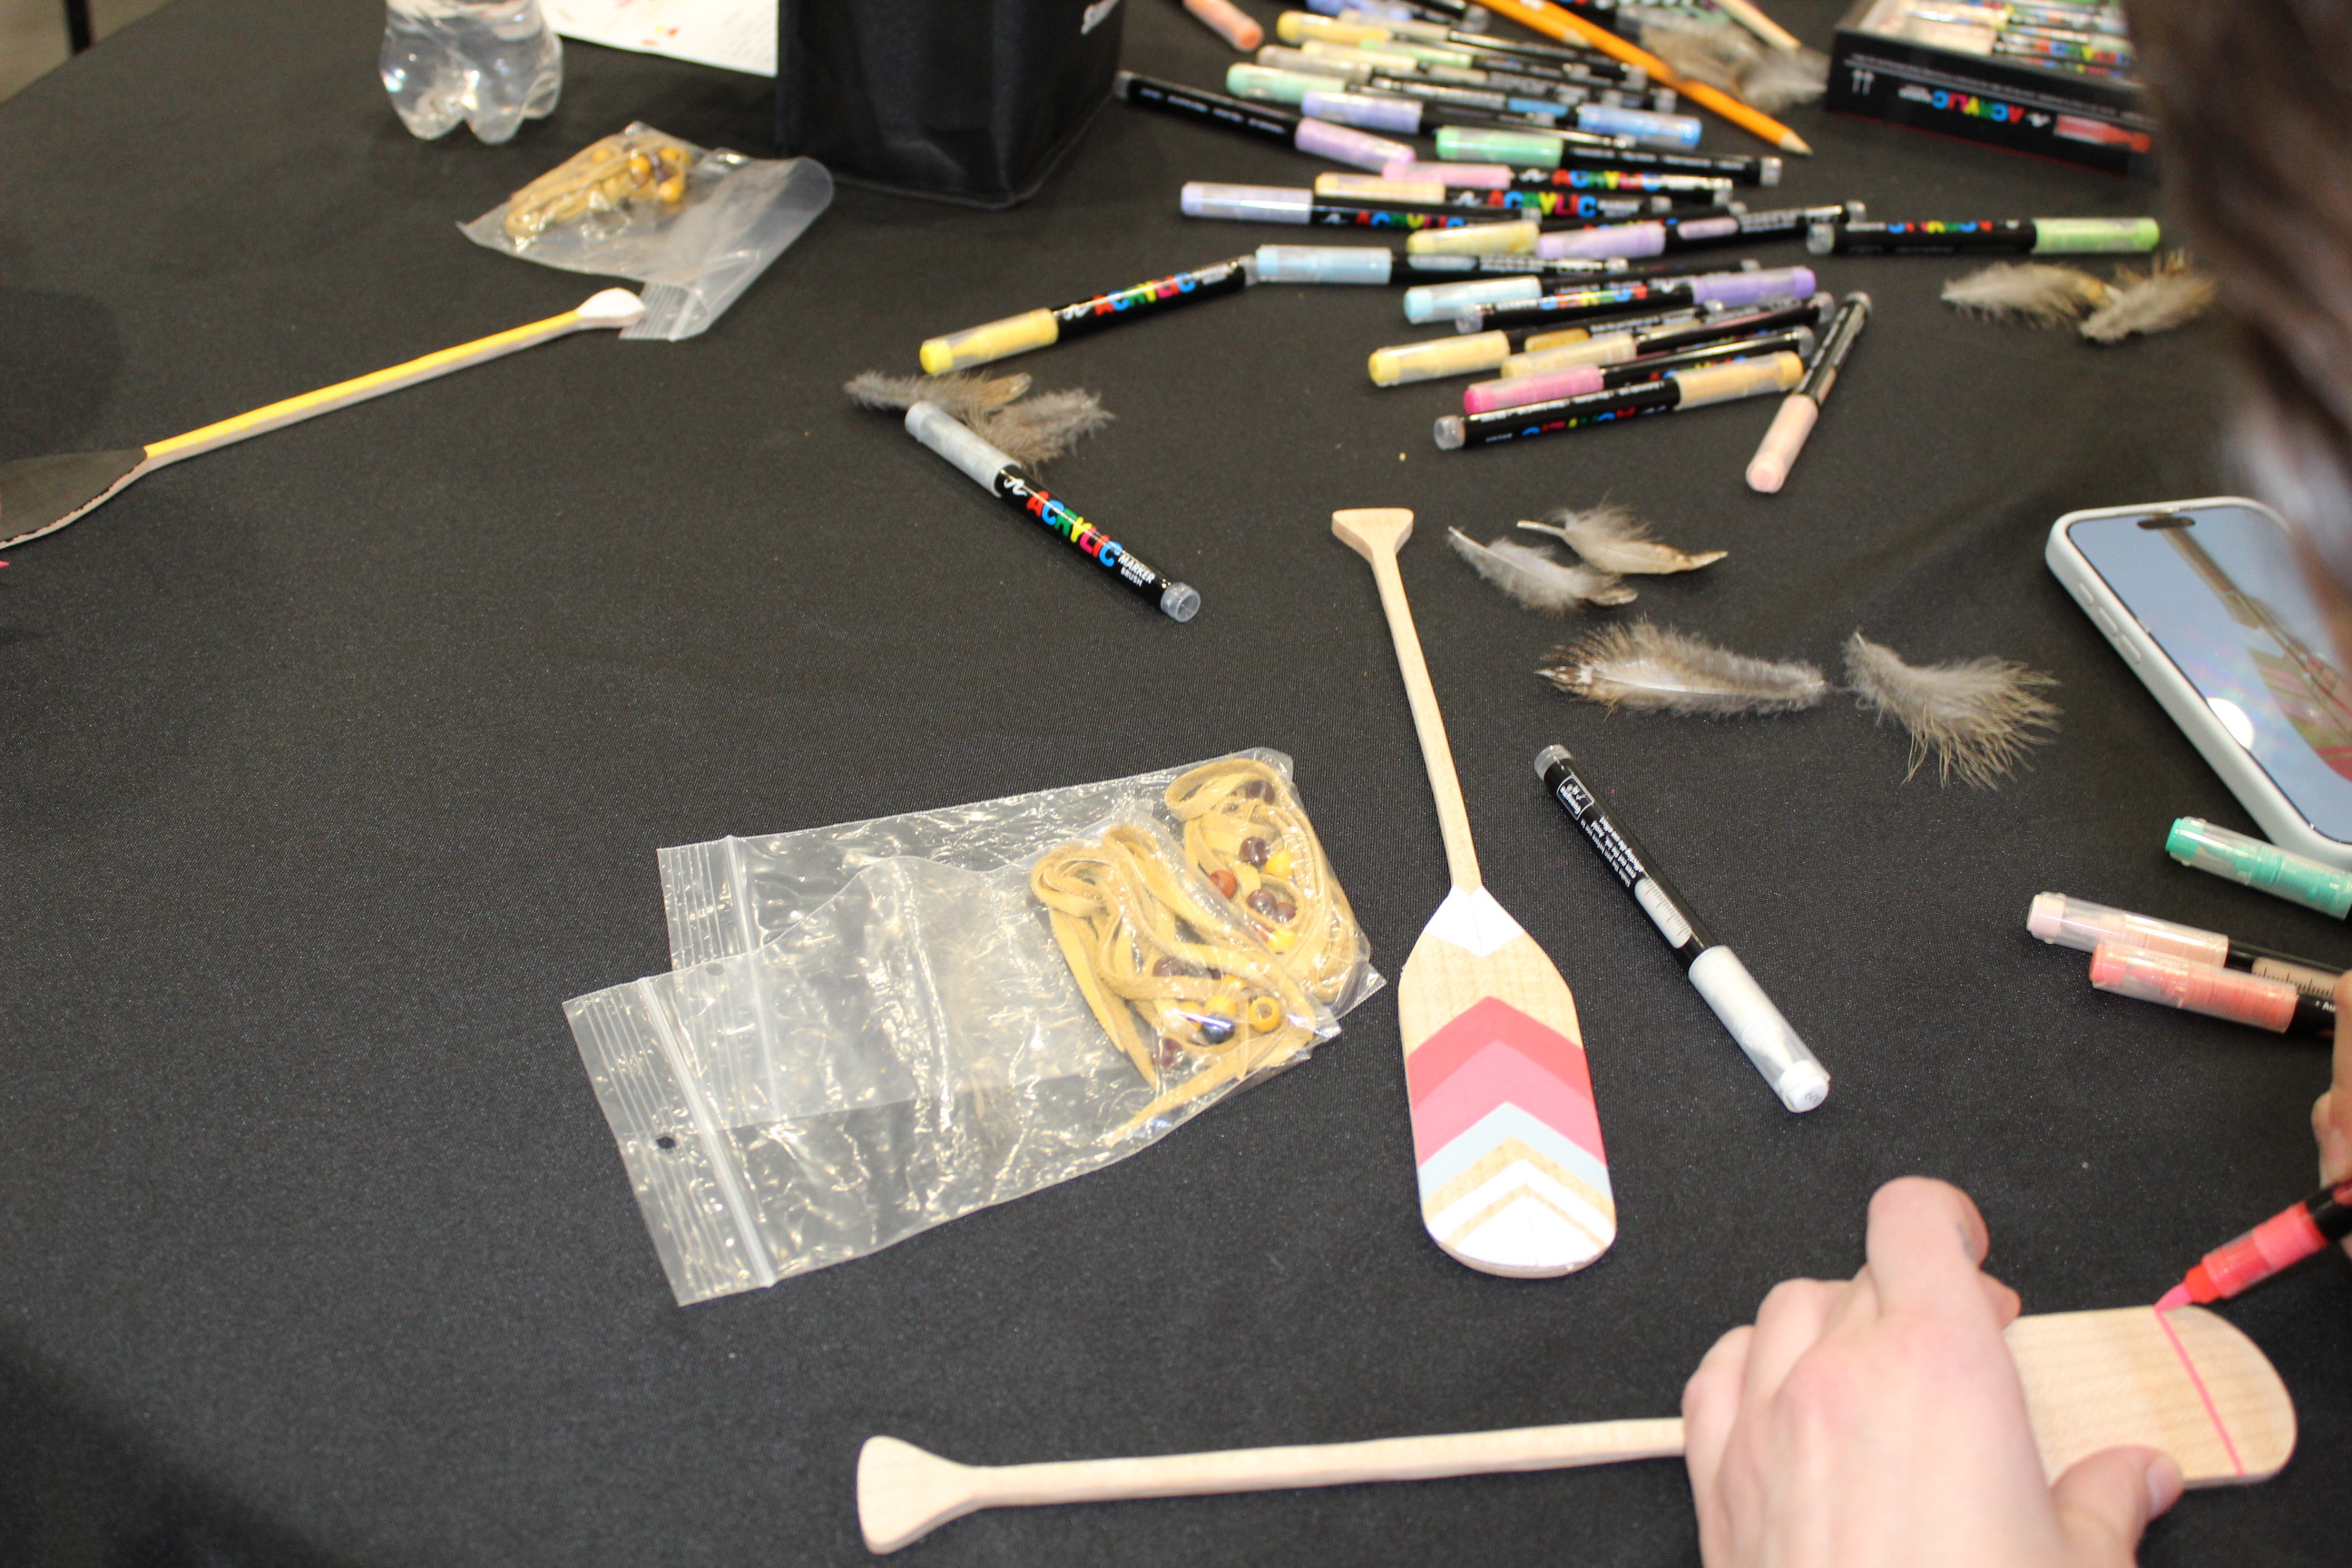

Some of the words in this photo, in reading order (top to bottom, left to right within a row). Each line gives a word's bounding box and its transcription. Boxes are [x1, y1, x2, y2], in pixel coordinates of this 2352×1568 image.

[1091, 270, 1198, 318] ACRYLIC
[1025, 490, 1123, 569] ACRYLIC
[1118, 551, 1155, 585] MARKER
[1119, 565, 1142, 588] BRUSH
